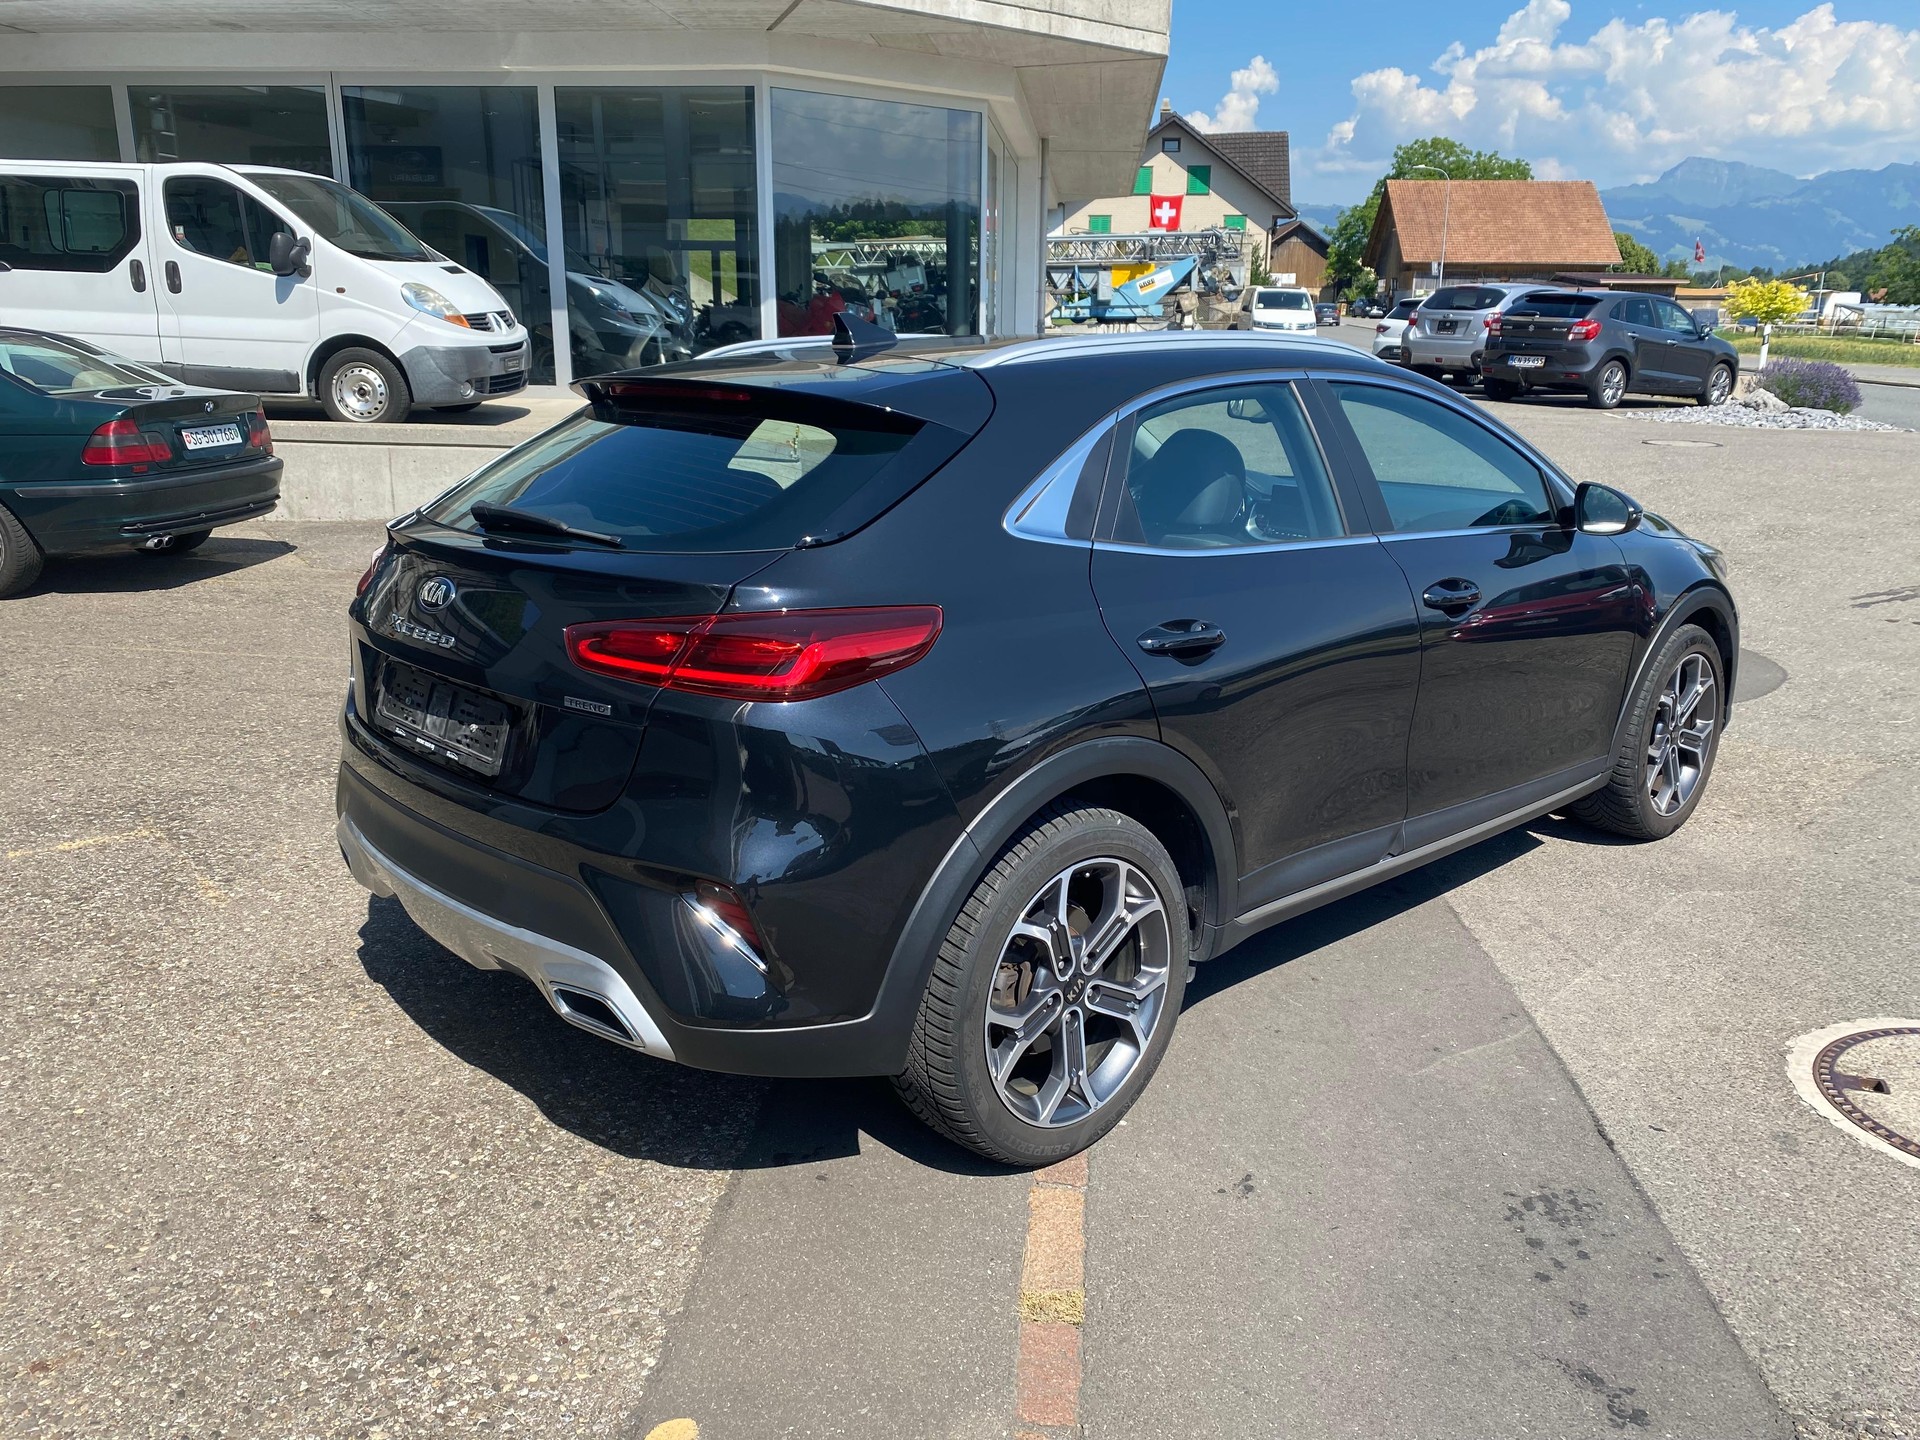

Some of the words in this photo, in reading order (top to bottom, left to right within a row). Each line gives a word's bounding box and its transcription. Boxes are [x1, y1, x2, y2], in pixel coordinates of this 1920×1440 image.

[421, 581, 447, 605] KIA
[567, 697, 606, 714] TREND
[1066, 978, 1085, 1002] KIA
[1003, 1134, 1072, 1156] SEMPERIT
